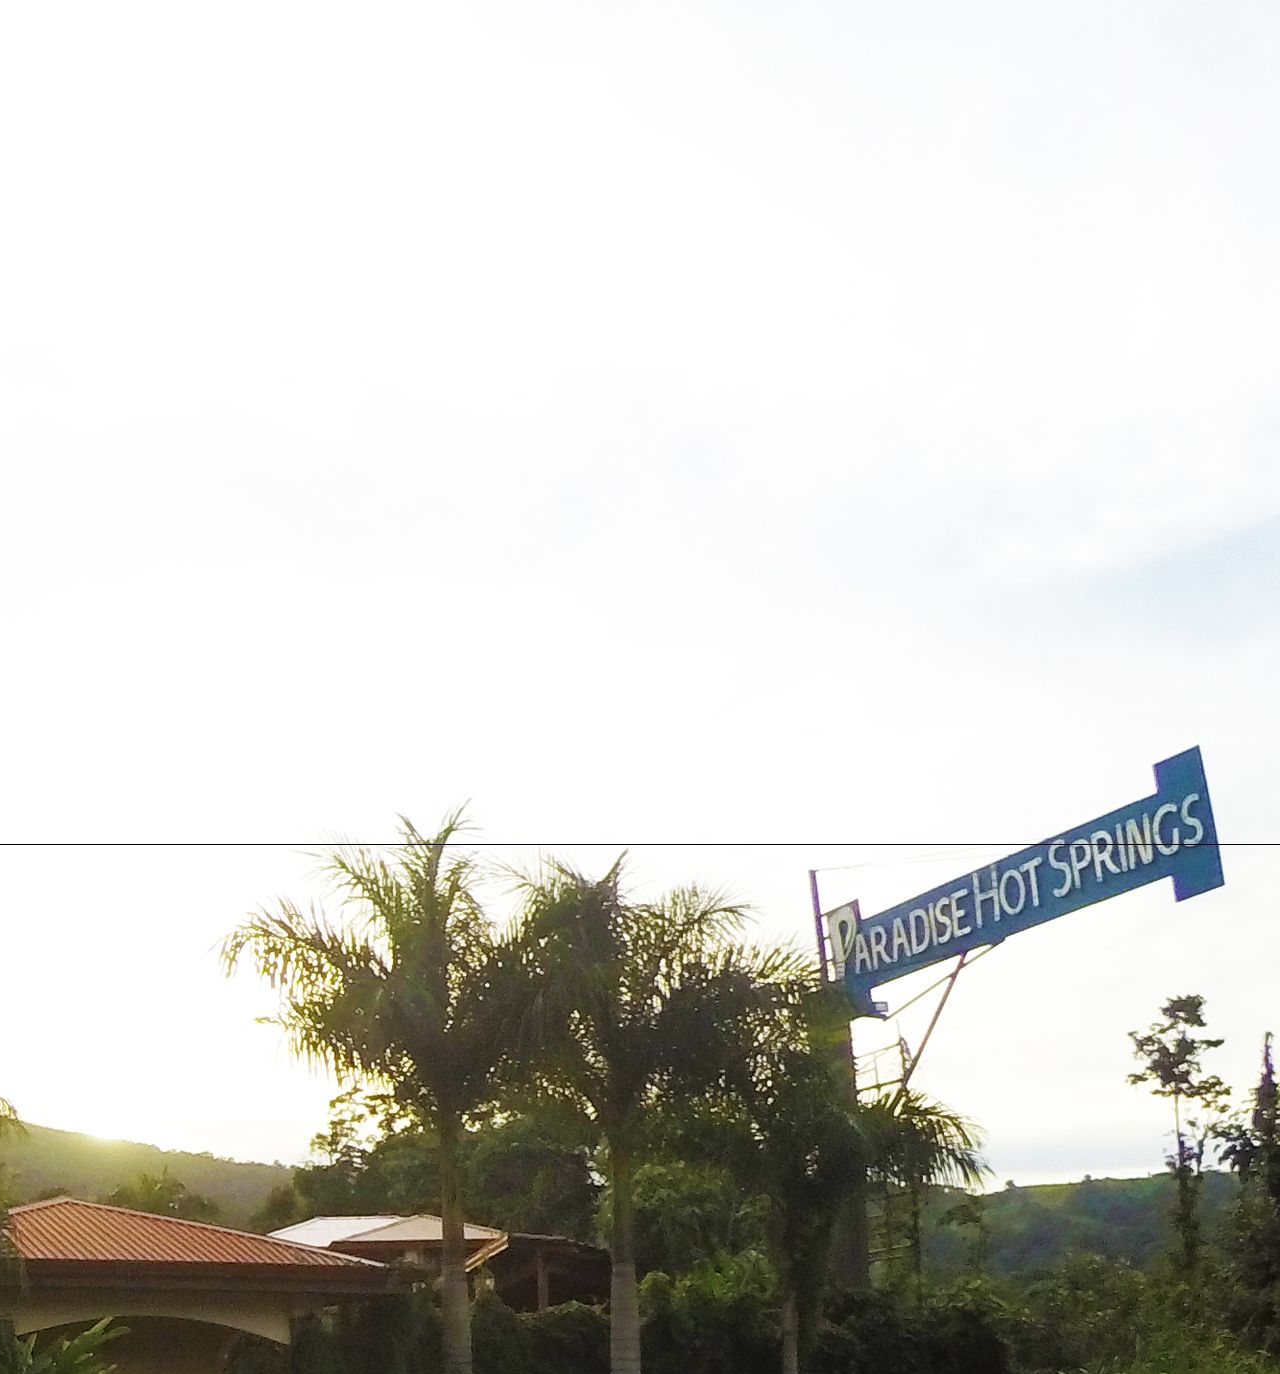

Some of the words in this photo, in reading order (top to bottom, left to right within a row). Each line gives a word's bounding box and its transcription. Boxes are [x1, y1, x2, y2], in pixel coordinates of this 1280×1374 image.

[829, 888, 972, 980] PARADISE
[972, 857, 1042, 929] HOT
[1047, 793, 1205, 898] SPRINGS
